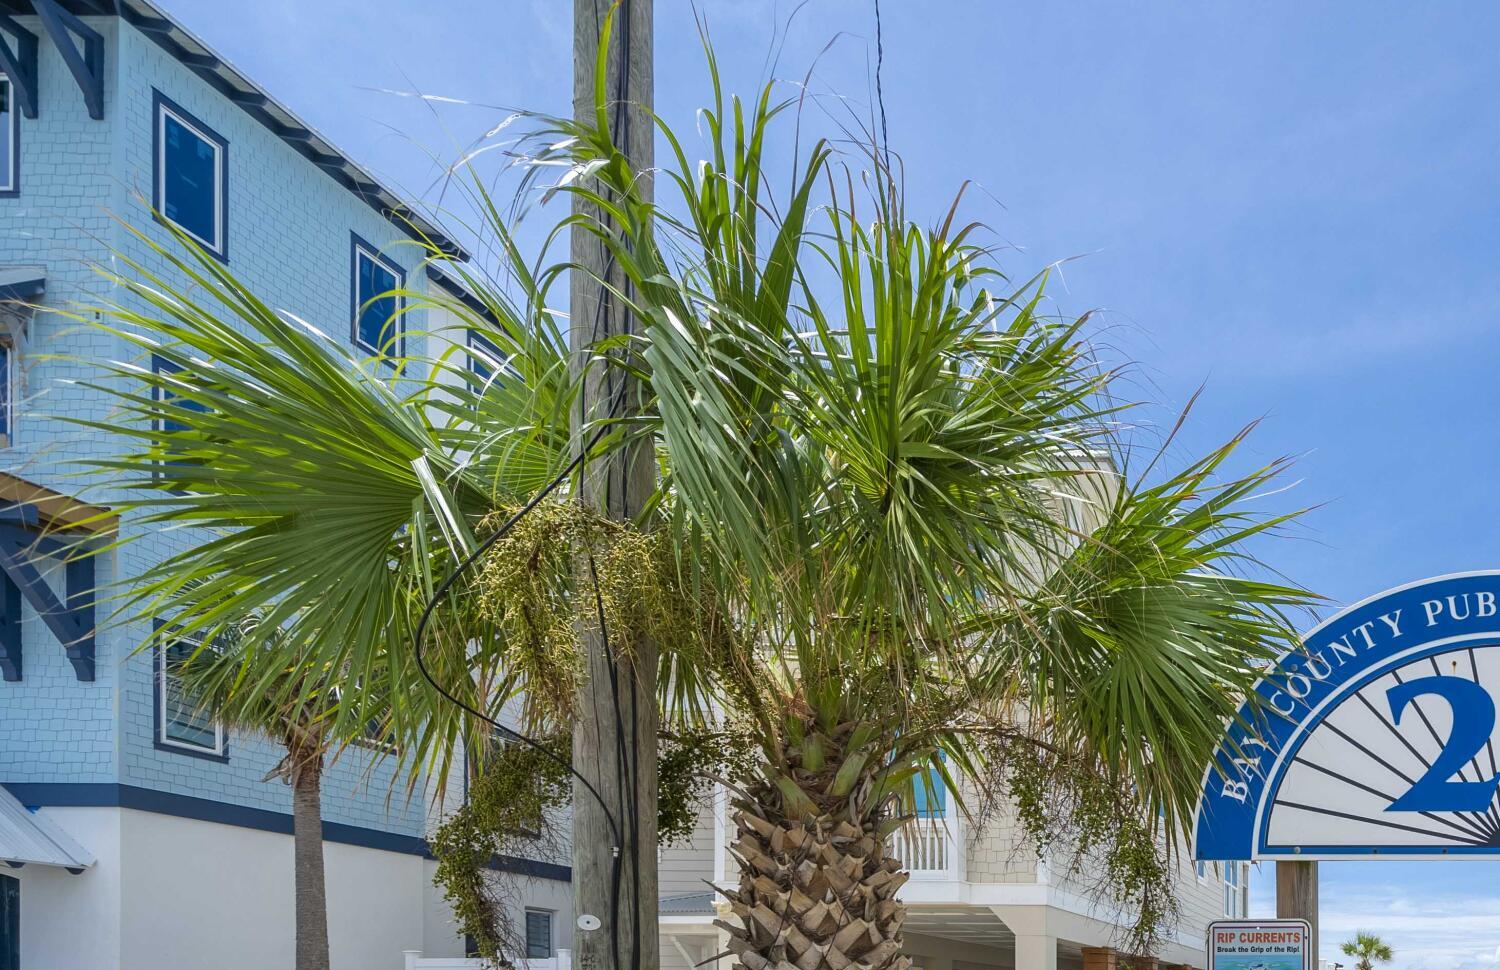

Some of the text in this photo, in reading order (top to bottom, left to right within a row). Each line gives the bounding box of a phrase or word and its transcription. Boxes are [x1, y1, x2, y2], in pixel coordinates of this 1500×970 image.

[1221, 723, 1270, 804] BAY
[1270, 609, 1404, 716] COUNTY
[1217, 932, 1300, 943] RIP CURRENTS
[1251, 946, 1264, 954] Grip
[1287, 946, 1299, 954] Rip!
